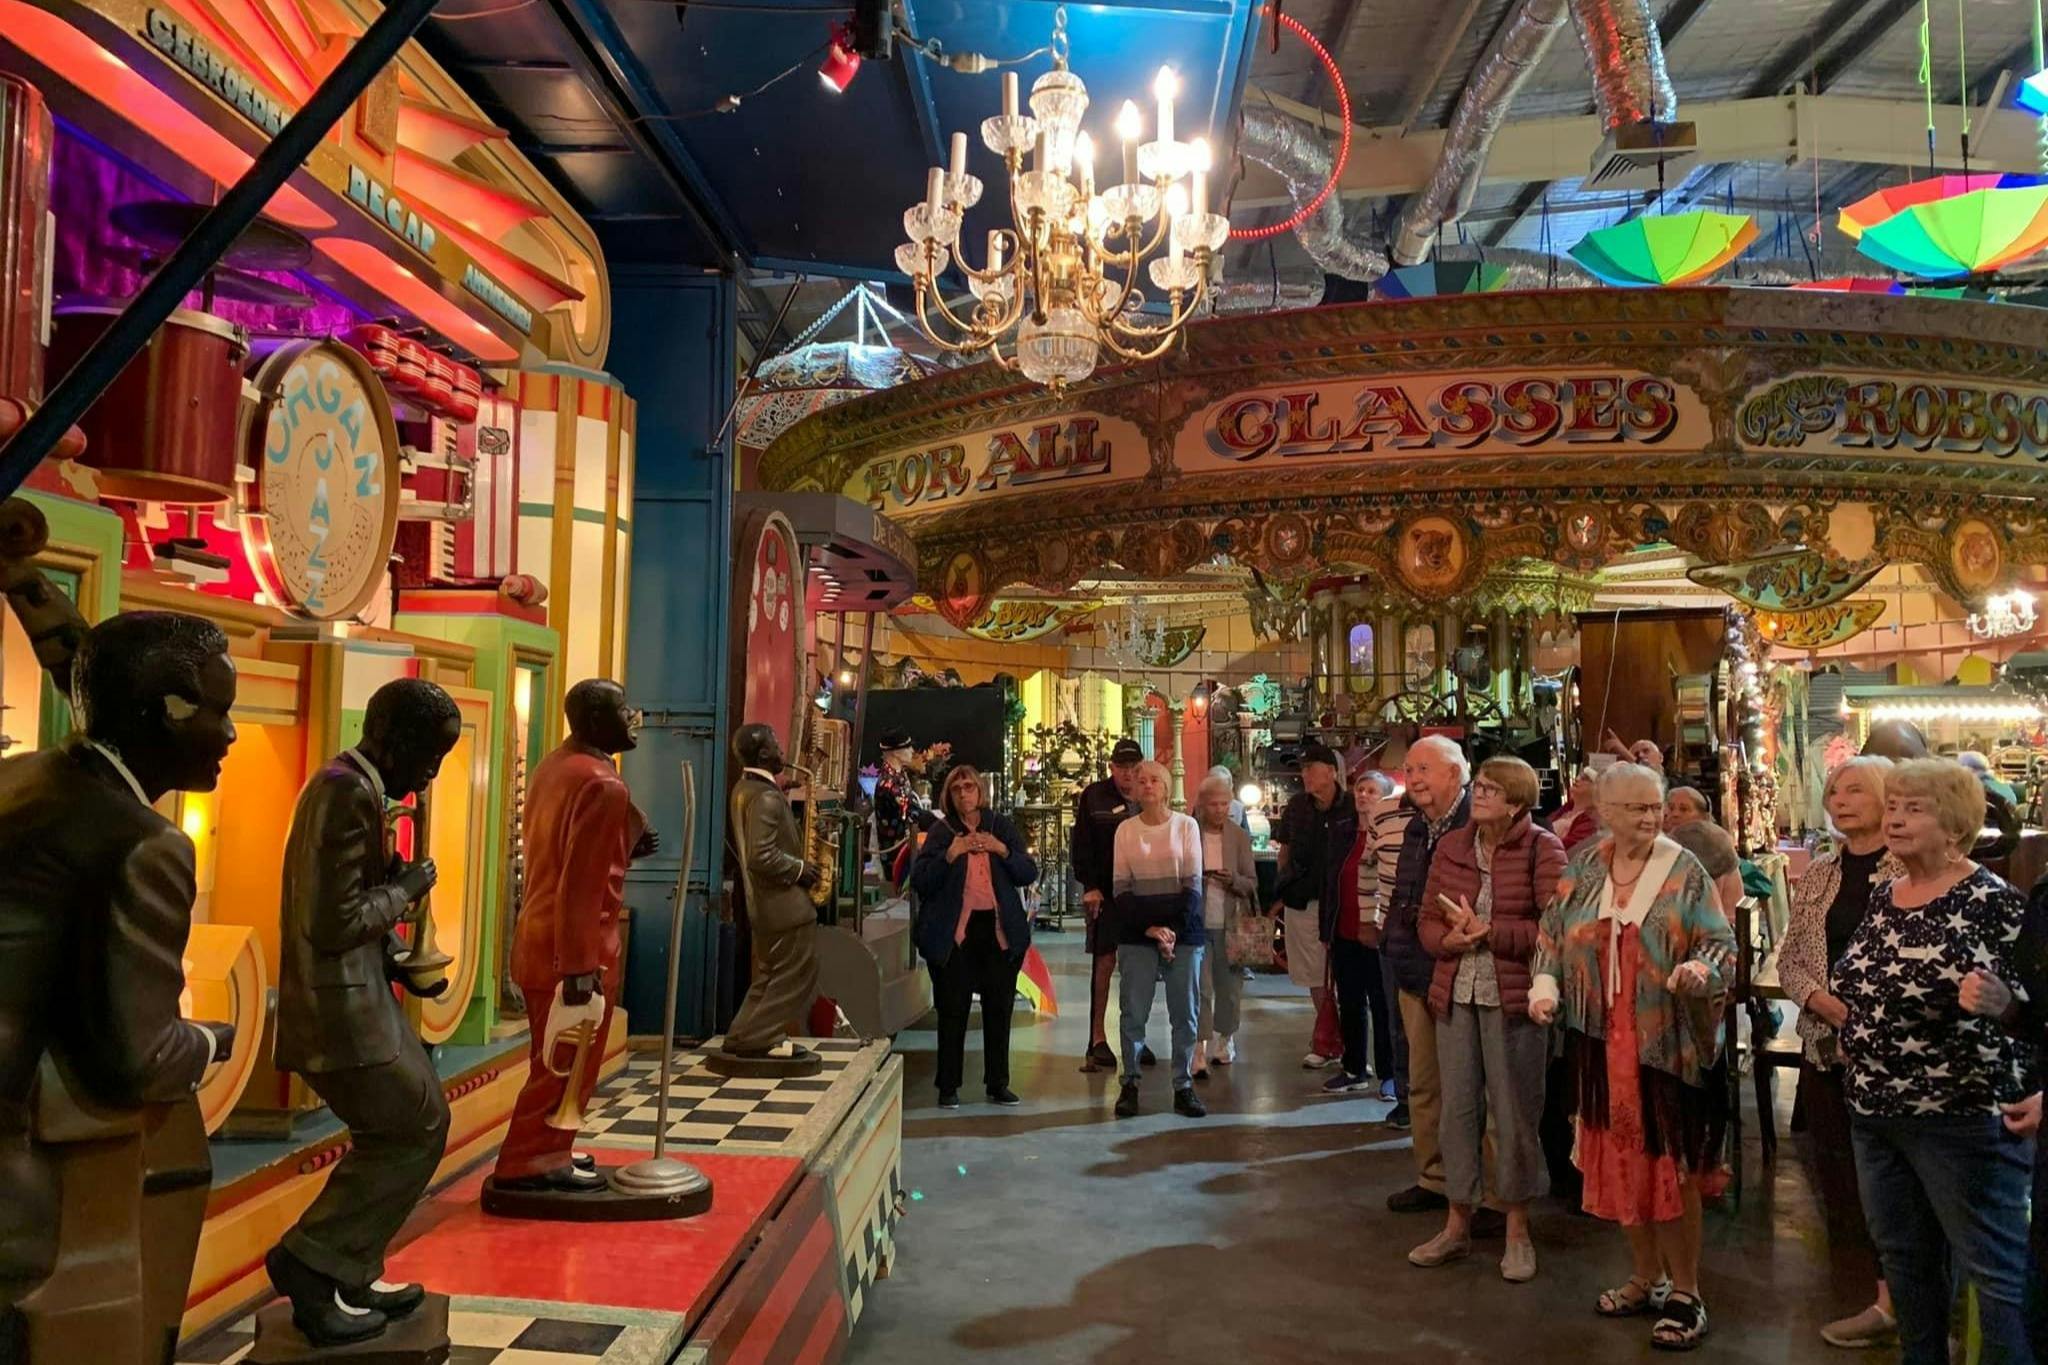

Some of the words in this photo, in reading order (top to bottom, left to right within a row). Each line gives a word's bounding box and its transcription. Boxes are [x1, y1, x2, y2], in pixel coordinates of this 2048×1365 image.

[347, 164, 436, 254] DECAP
[266, 361, 381, 496] ORGAN
[863, 443, 971, 510] FOR
[976, 417, 1111, 491] ALL
[1203, 374, 1680, 460] CLASSES
[304, 429, 334, 608] JAZZ
